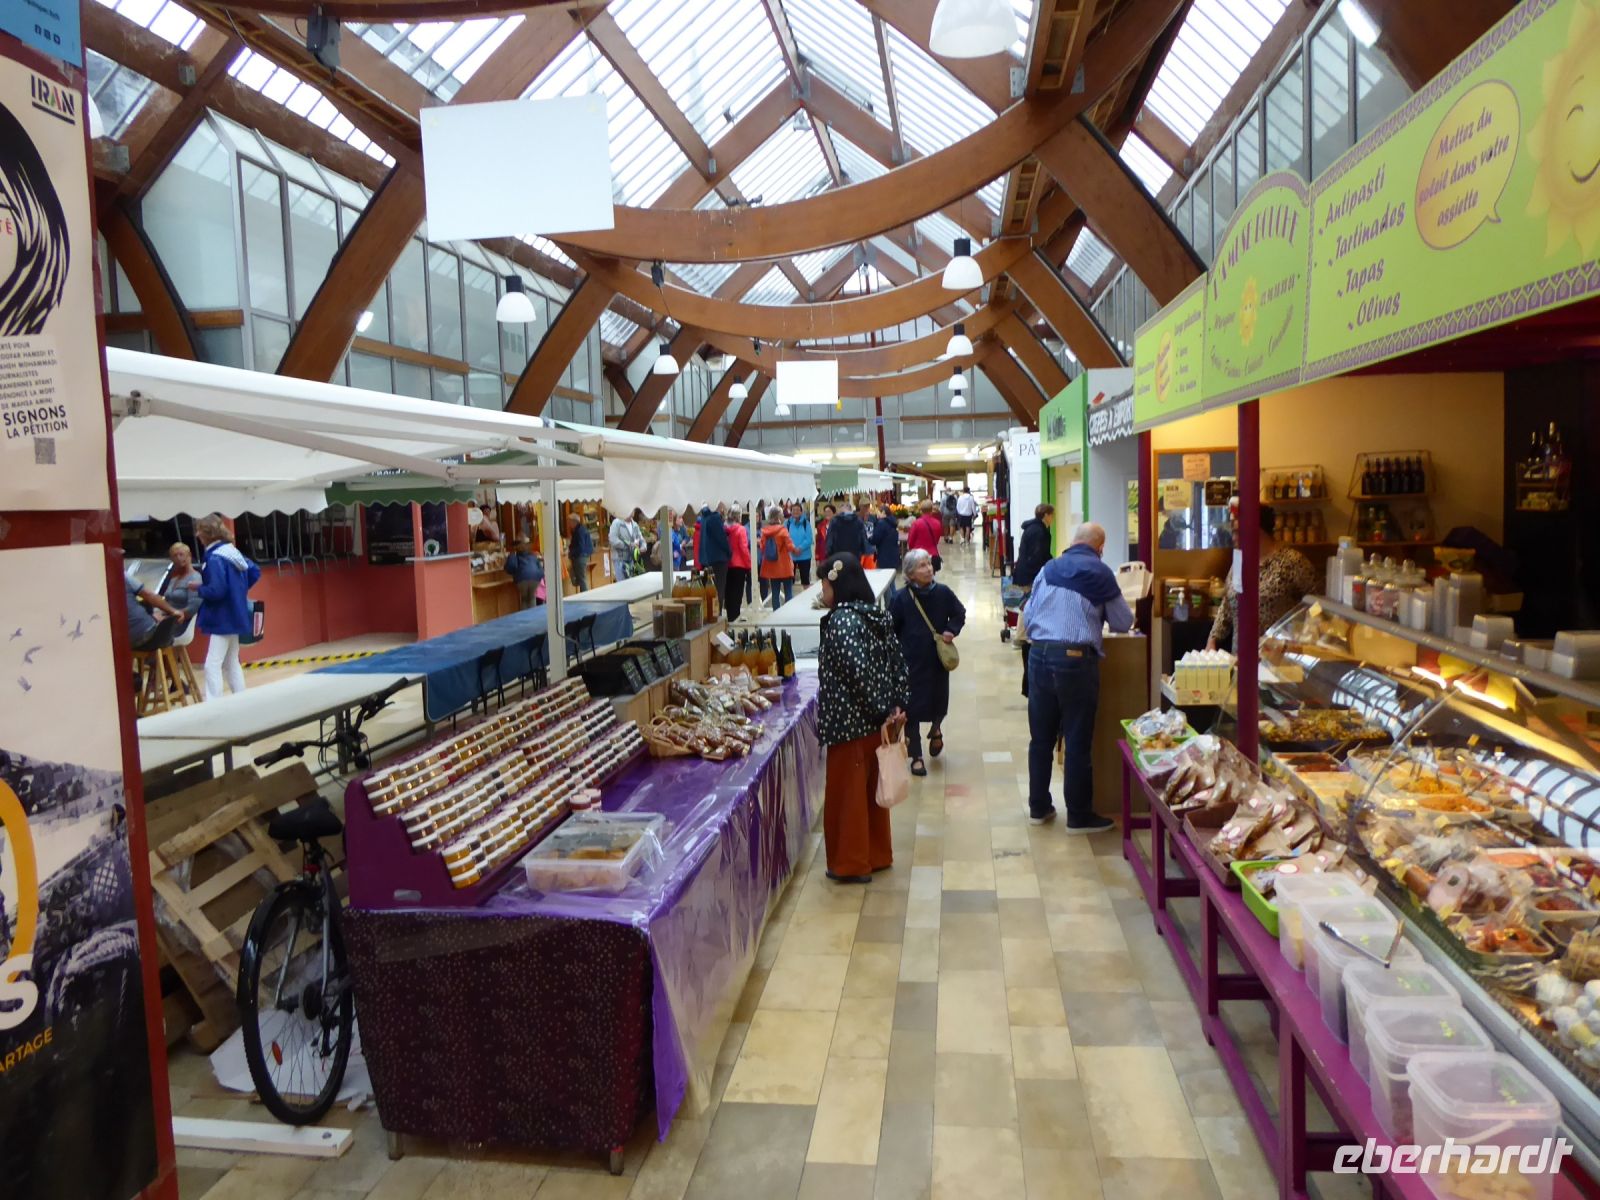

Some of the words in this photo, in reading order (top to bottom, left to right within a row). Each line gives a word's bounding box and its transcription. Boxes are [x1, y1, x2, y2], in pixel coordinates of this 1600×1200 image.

[31, 74, 75, 116] IRAN
[1436, 121, 1475, 160] Mettez
[1476, 106, 1493, 132] du
[1450, 155, 1478, 185] dans
[1480, 135, 1510, 166] votre
[1325, 162, 1386, 228] Antipasti
[1437, 188, 1479, 227] assiette
[1335, 202, 1406, 260] Tartinades
[1345, 258, 1385, 293] Tapas
[1356, 291, 1401, 327] Olives
[3, 405, 67, 426] SIGNONS
[6, 427, 20, 439] LA
[23, 419, 69, 436] PÉTITION
